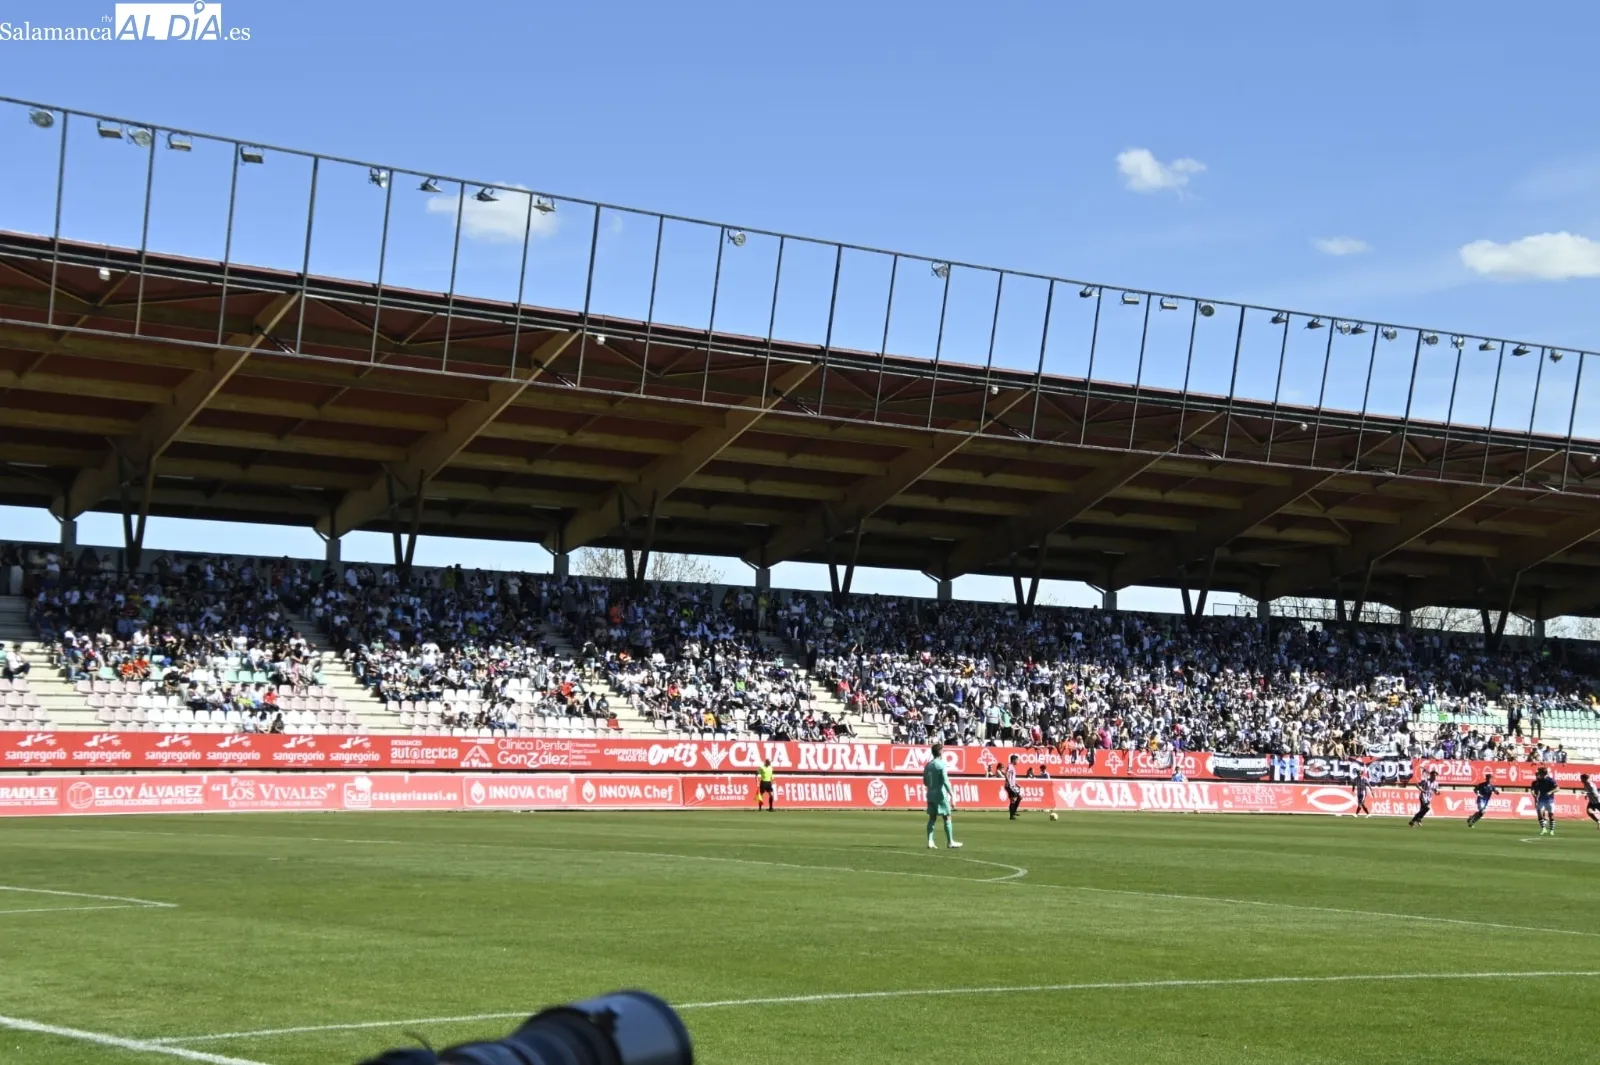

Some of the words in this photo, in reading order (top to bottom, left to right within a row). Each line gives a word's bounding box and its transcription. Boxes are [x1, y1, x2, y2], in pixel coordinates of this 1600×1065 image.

[498, 739, 533, 750] Clínica
[535, 740, 570, 751] Dental
[5, 748, 67, 762] sangregorio
[72, 749, 132, 762] sangregorio
[145, 750, 201, 762] sangregorio
[206, 750, 261, 762] sangregorio
[272, 751, 325, 763] sangregorio
[329, 751, 381, 763] sangregorio
[729, 742, 792, 768] CAJA
[797, 744, 885, 771] RURAL
[1059, 766, 1094, 774] ZAMORA
[95, 786, 135, 799] ELOY
[138, 783, 204, 799] ÁLVAREZ
[489, 785, 535, 799] INNOVA
[537, 785, 569, 802] Chef
[599, 785, 642, 799] INNOVA
[644, 785, 674, 802] Chef
[705, 784, 749, 795] VERSUS
[785, 781, 852, 802] FEDERACIÓN
[1081, 782, 1137, 808] CAJA
[1138, 782, 1218, 809] RURAL
[1371, 799, 1391, 813] JOSÉ
